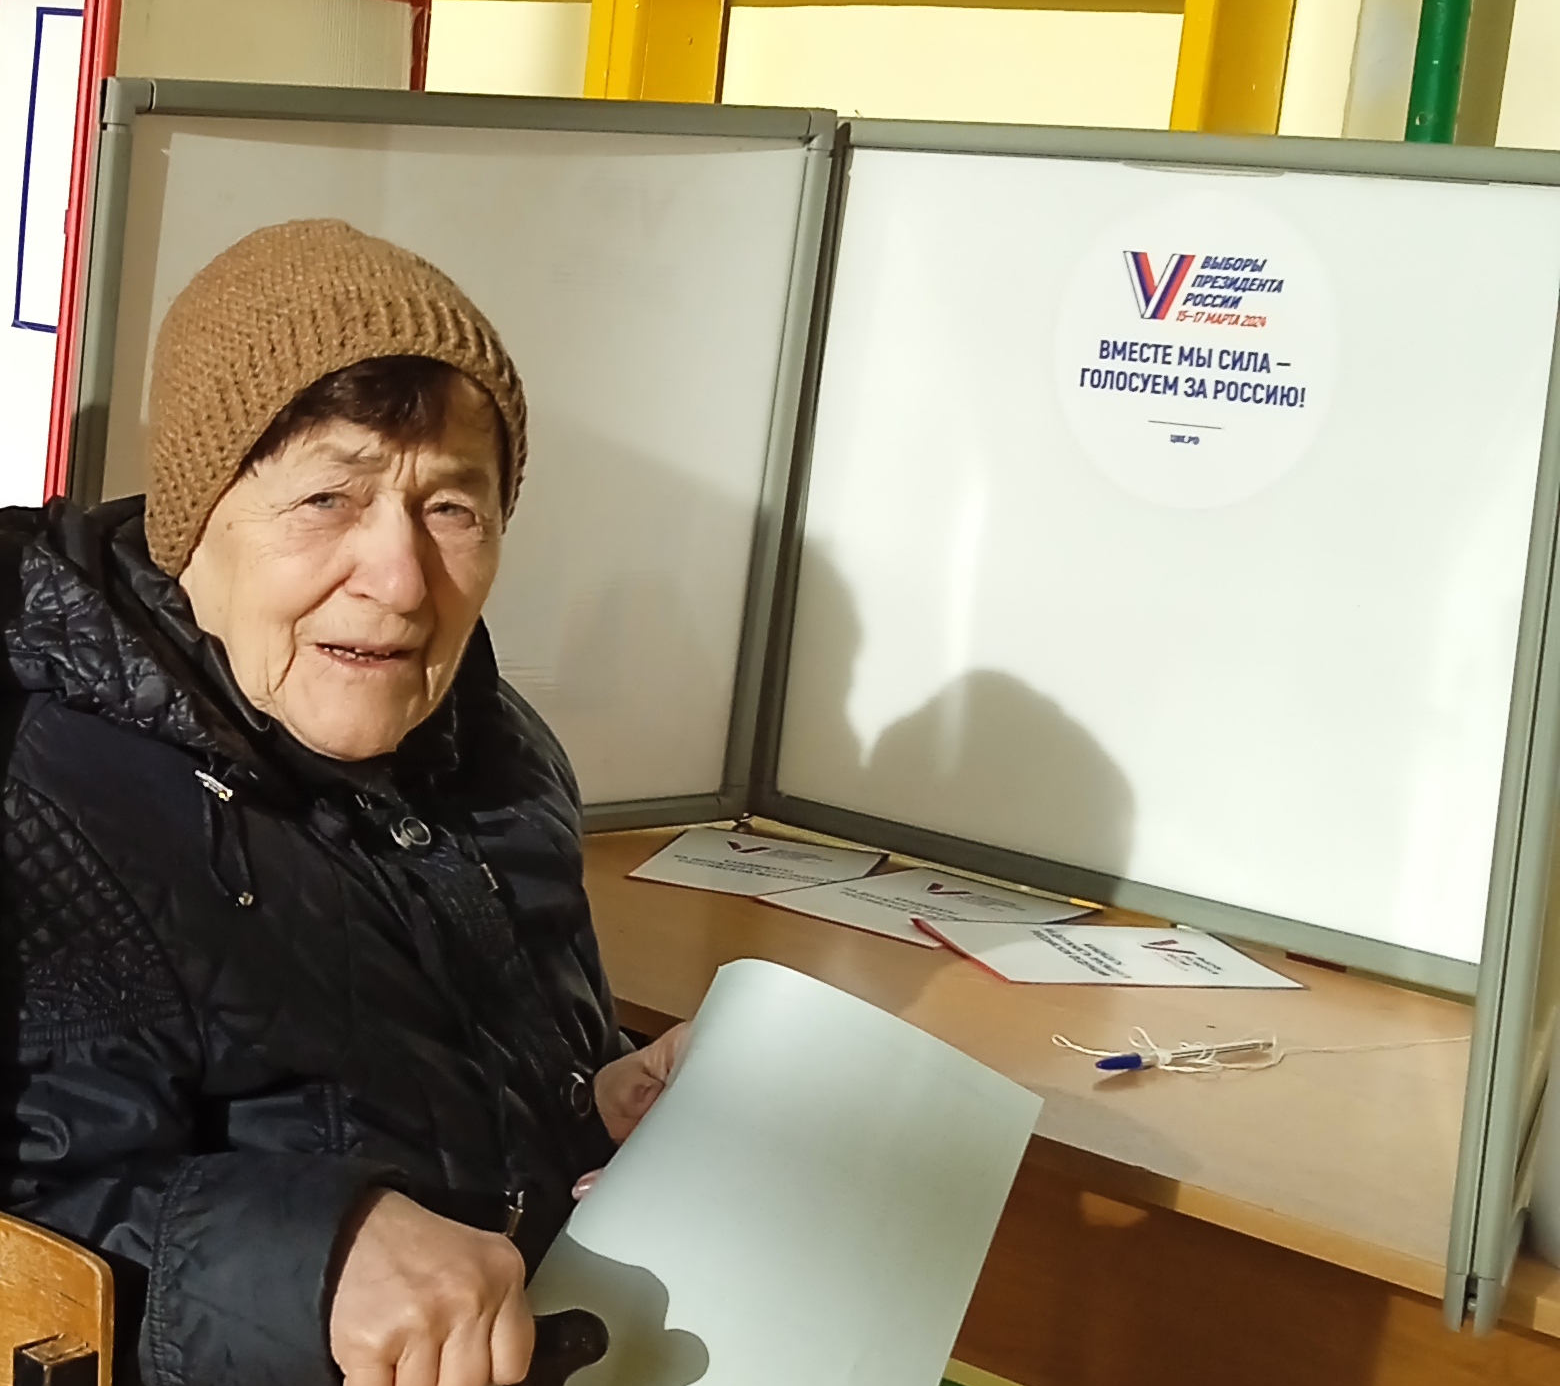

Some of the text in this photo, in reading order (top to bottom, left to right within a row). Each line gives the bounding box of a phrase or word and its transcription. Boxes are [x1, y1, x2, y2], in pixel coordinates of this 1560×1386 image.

[1200, 255, 1268, 273] ВЫБОРЫ
[1190, 274, 1285, 294] ПРЕЗИДЕНТА
[1181, 292, 1243, 310] РОССИИ
[1204, 312, 1241, 326] МАРТА
[1098, 339, 1174, 366] ВМЕСТЕ
[1177, 345, 1214, 369] МЫ
[1218, 349, 1271, 374] СИЛА
[1079, 367, 1306, 409] ГОЛОСУЕМ ЗА РОССИЮ!
